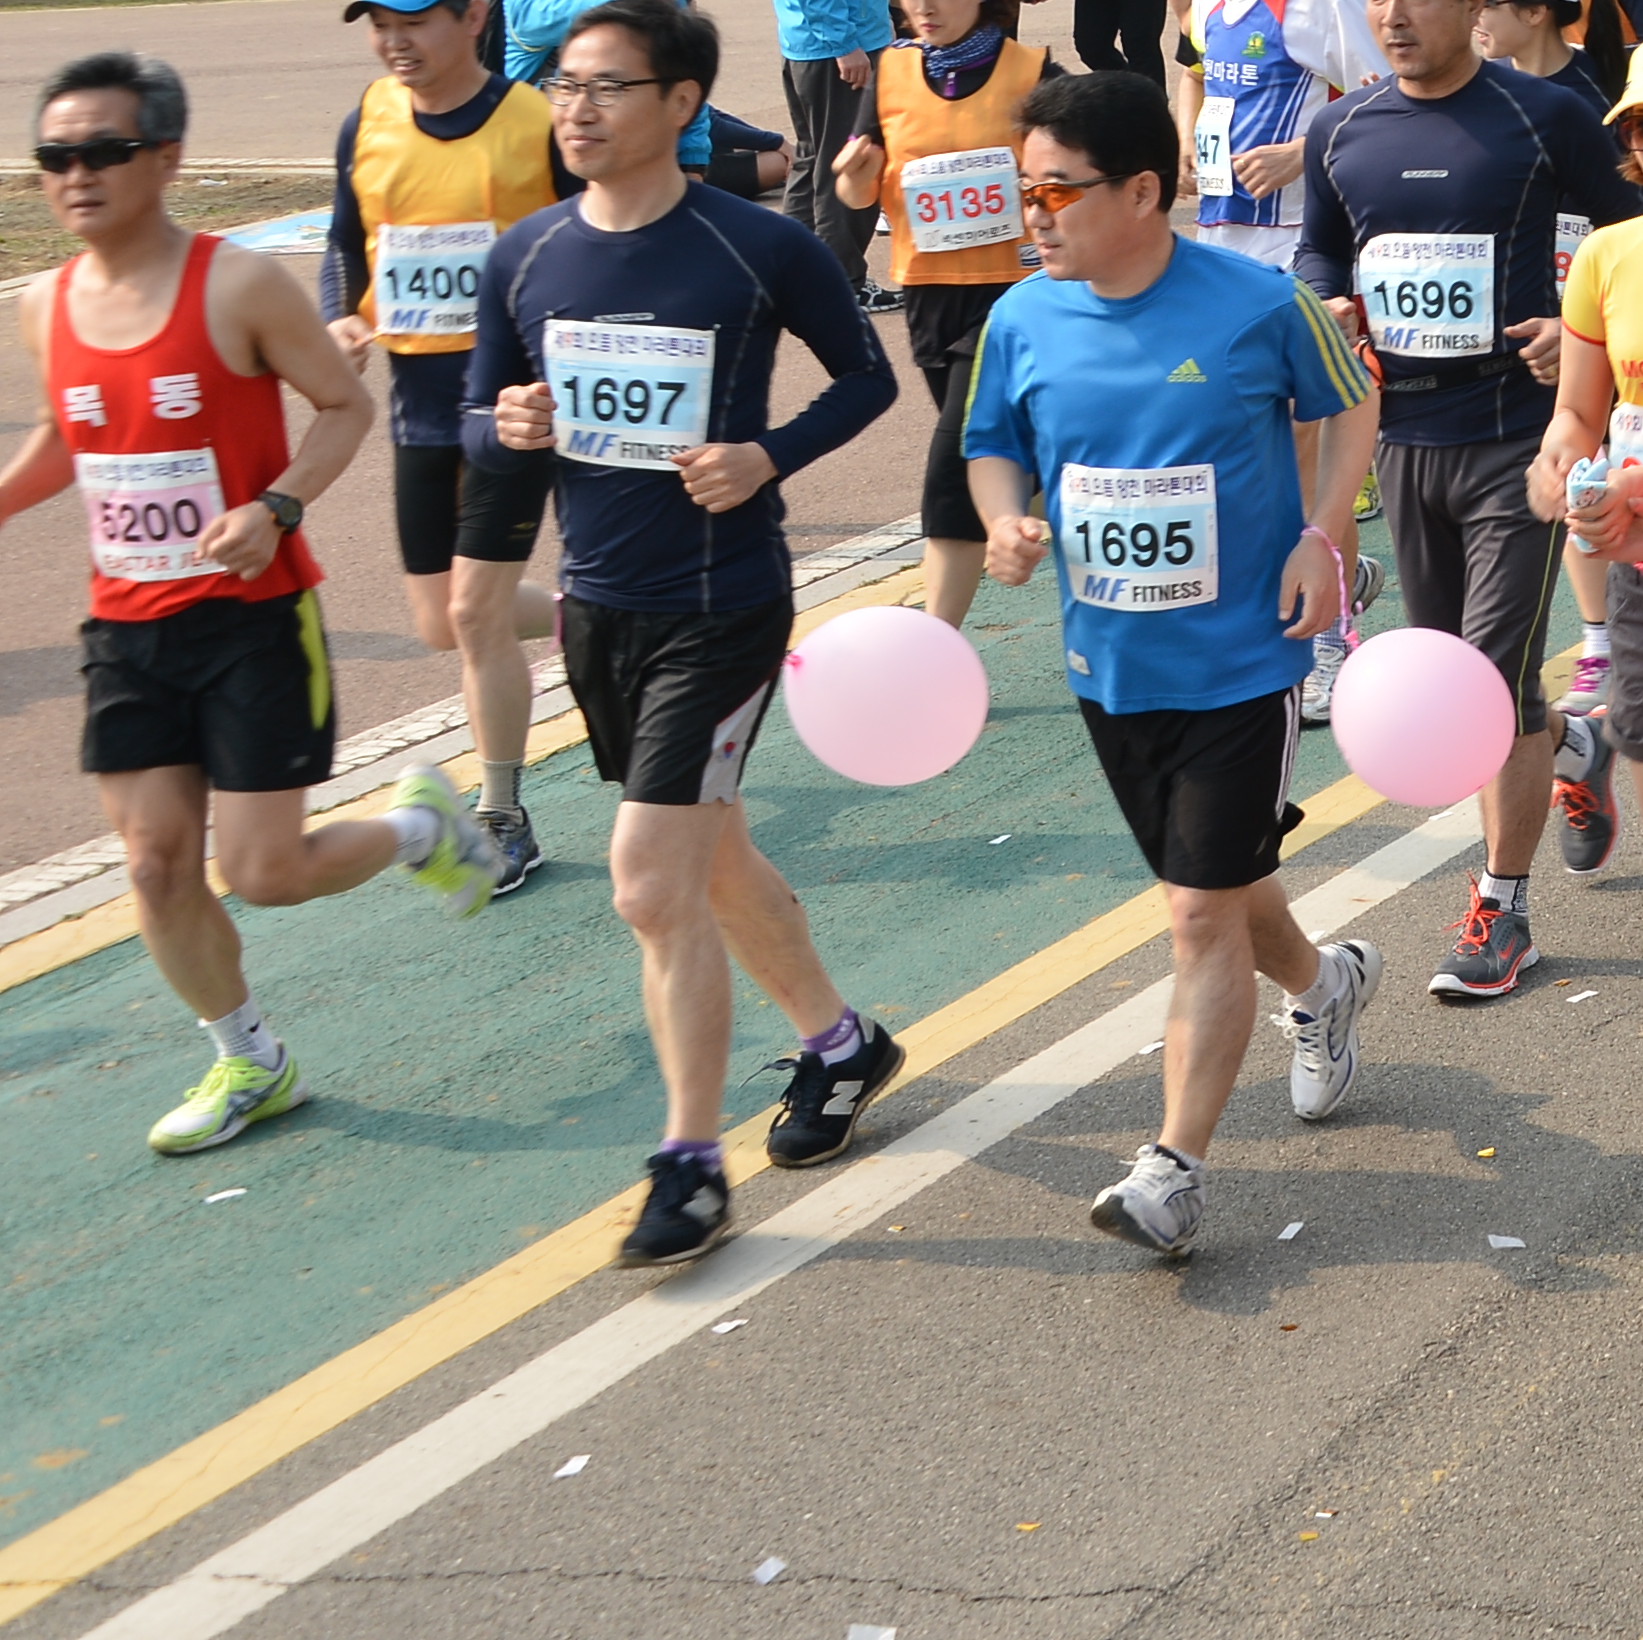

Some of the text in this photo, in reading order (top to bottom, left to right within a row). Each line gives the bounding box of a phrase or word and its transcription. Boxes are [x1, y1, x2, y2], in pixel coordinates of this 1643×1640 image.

[965, 151, 1011, 169] 마라톤대회
[915, 183, 1007, 224] 3135
[1434, 241, 1487, 259] 마라톤대회
[386, 264, 479, 301] 1400
[1374, 279, 1473, 319] 1696
[390, 309, 479, 328] MF FITNE
[641, 335, 707, 358] 마라톤대회
[1383, 326, 1480, 350] MF FITNESS
[1167, 372, 1207, 384] adidas
[63, 371, 202, 427] 목 동
[562, 374, 688, 426] 1697
[567, 429, 620, 458] MF
[1093, 478, 1114, 498] 으뜸
[1117, 478, 1139, 499] 양천
[1144, 473, 1208, 497] 마라톤대회
[103, 498, 201, 542] 5200
[1076, 519, 1194, 568] 1695
[1084, 575, 1203, 603] MF FITNESS
